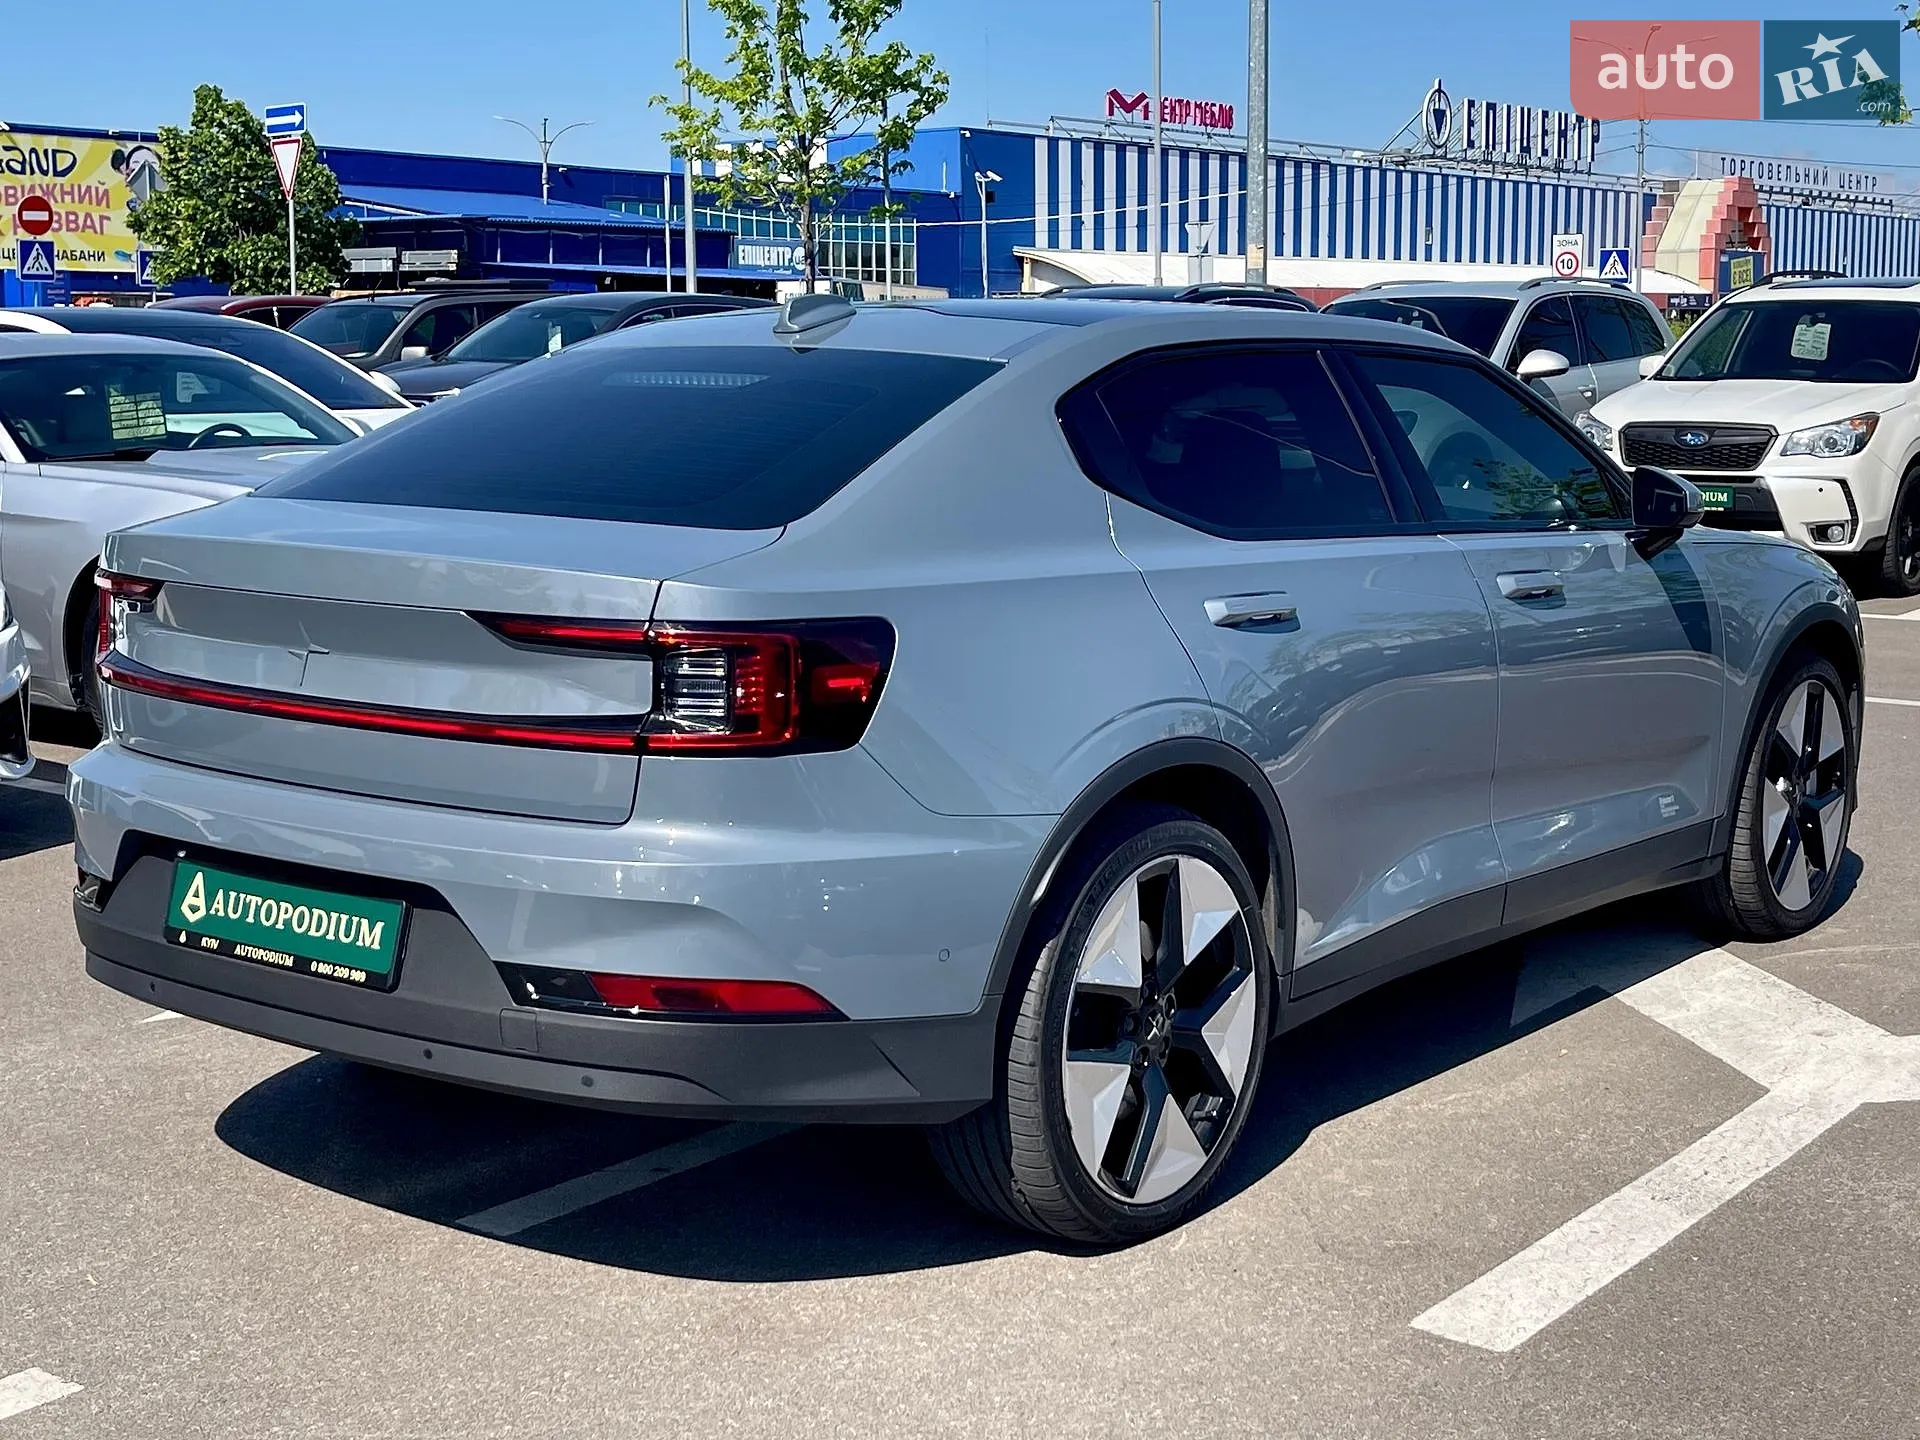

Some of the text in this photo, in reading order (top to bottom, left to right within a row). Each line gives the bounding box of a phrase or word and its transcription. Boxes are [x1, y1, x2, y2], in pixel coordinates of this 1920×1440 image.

[1160, 97, 1191, 125] ЕНТР
[1462, 97, 1601, 162] ЕПІЦЕНТР
[1721, 156, 1878, 193] ТОРГОВЕЛЬНИЙ ЦЕНТР
[0, 180, 110, 209] ВИЖНИЙ
[1560, 258, 1573, 269] 10
[208, 888, 385, 950] AUTOPODIUM
[201, 936, 220, 950] KYIV
[234, 944, 294, 967] AUTOPODIUM
[310, 960, 318, 972] 0
[317, 962, 334, 975] 800
